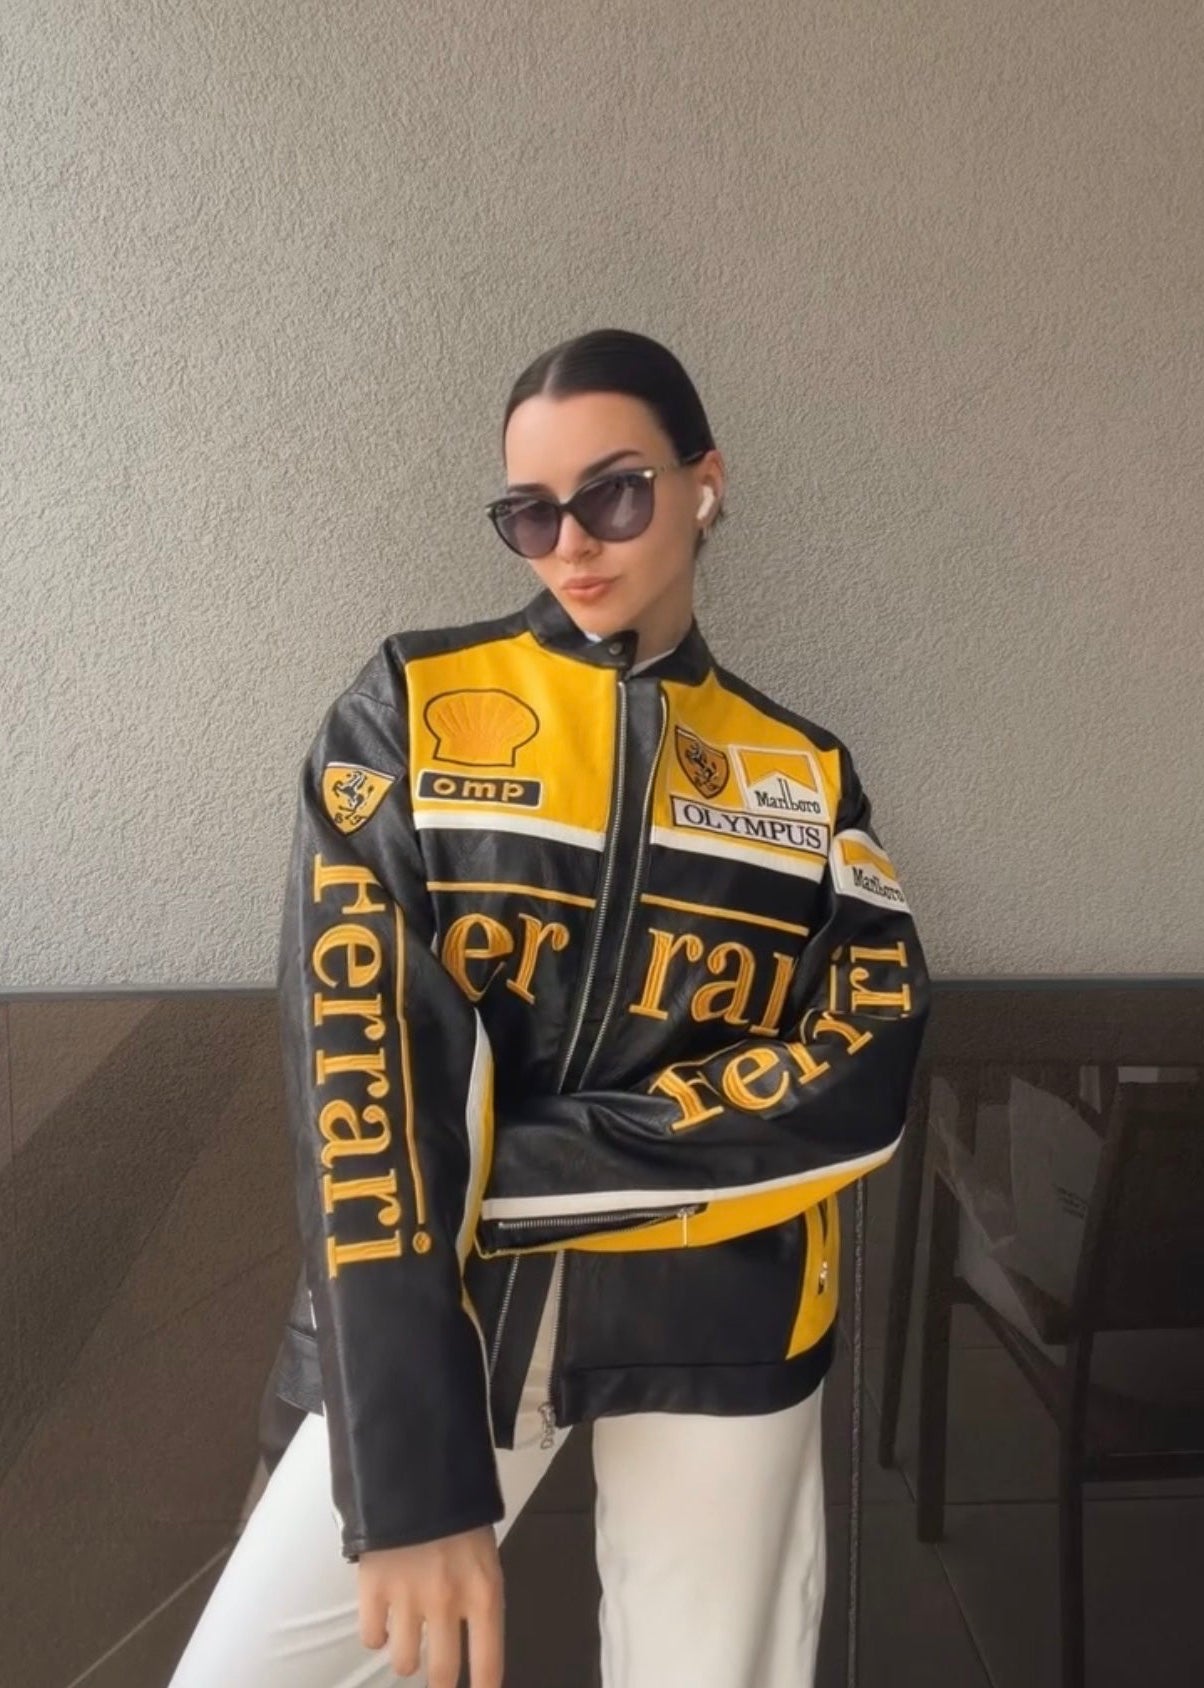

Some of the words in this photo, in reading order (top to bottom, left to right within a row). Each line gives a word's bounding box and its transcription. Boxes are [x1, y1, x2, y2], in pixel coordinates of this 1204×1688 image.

[433, 777, 525, 801] omp
[754, 777, 821, 814] Marlboro
[683, 804, 822, 849] OLYMPUS
